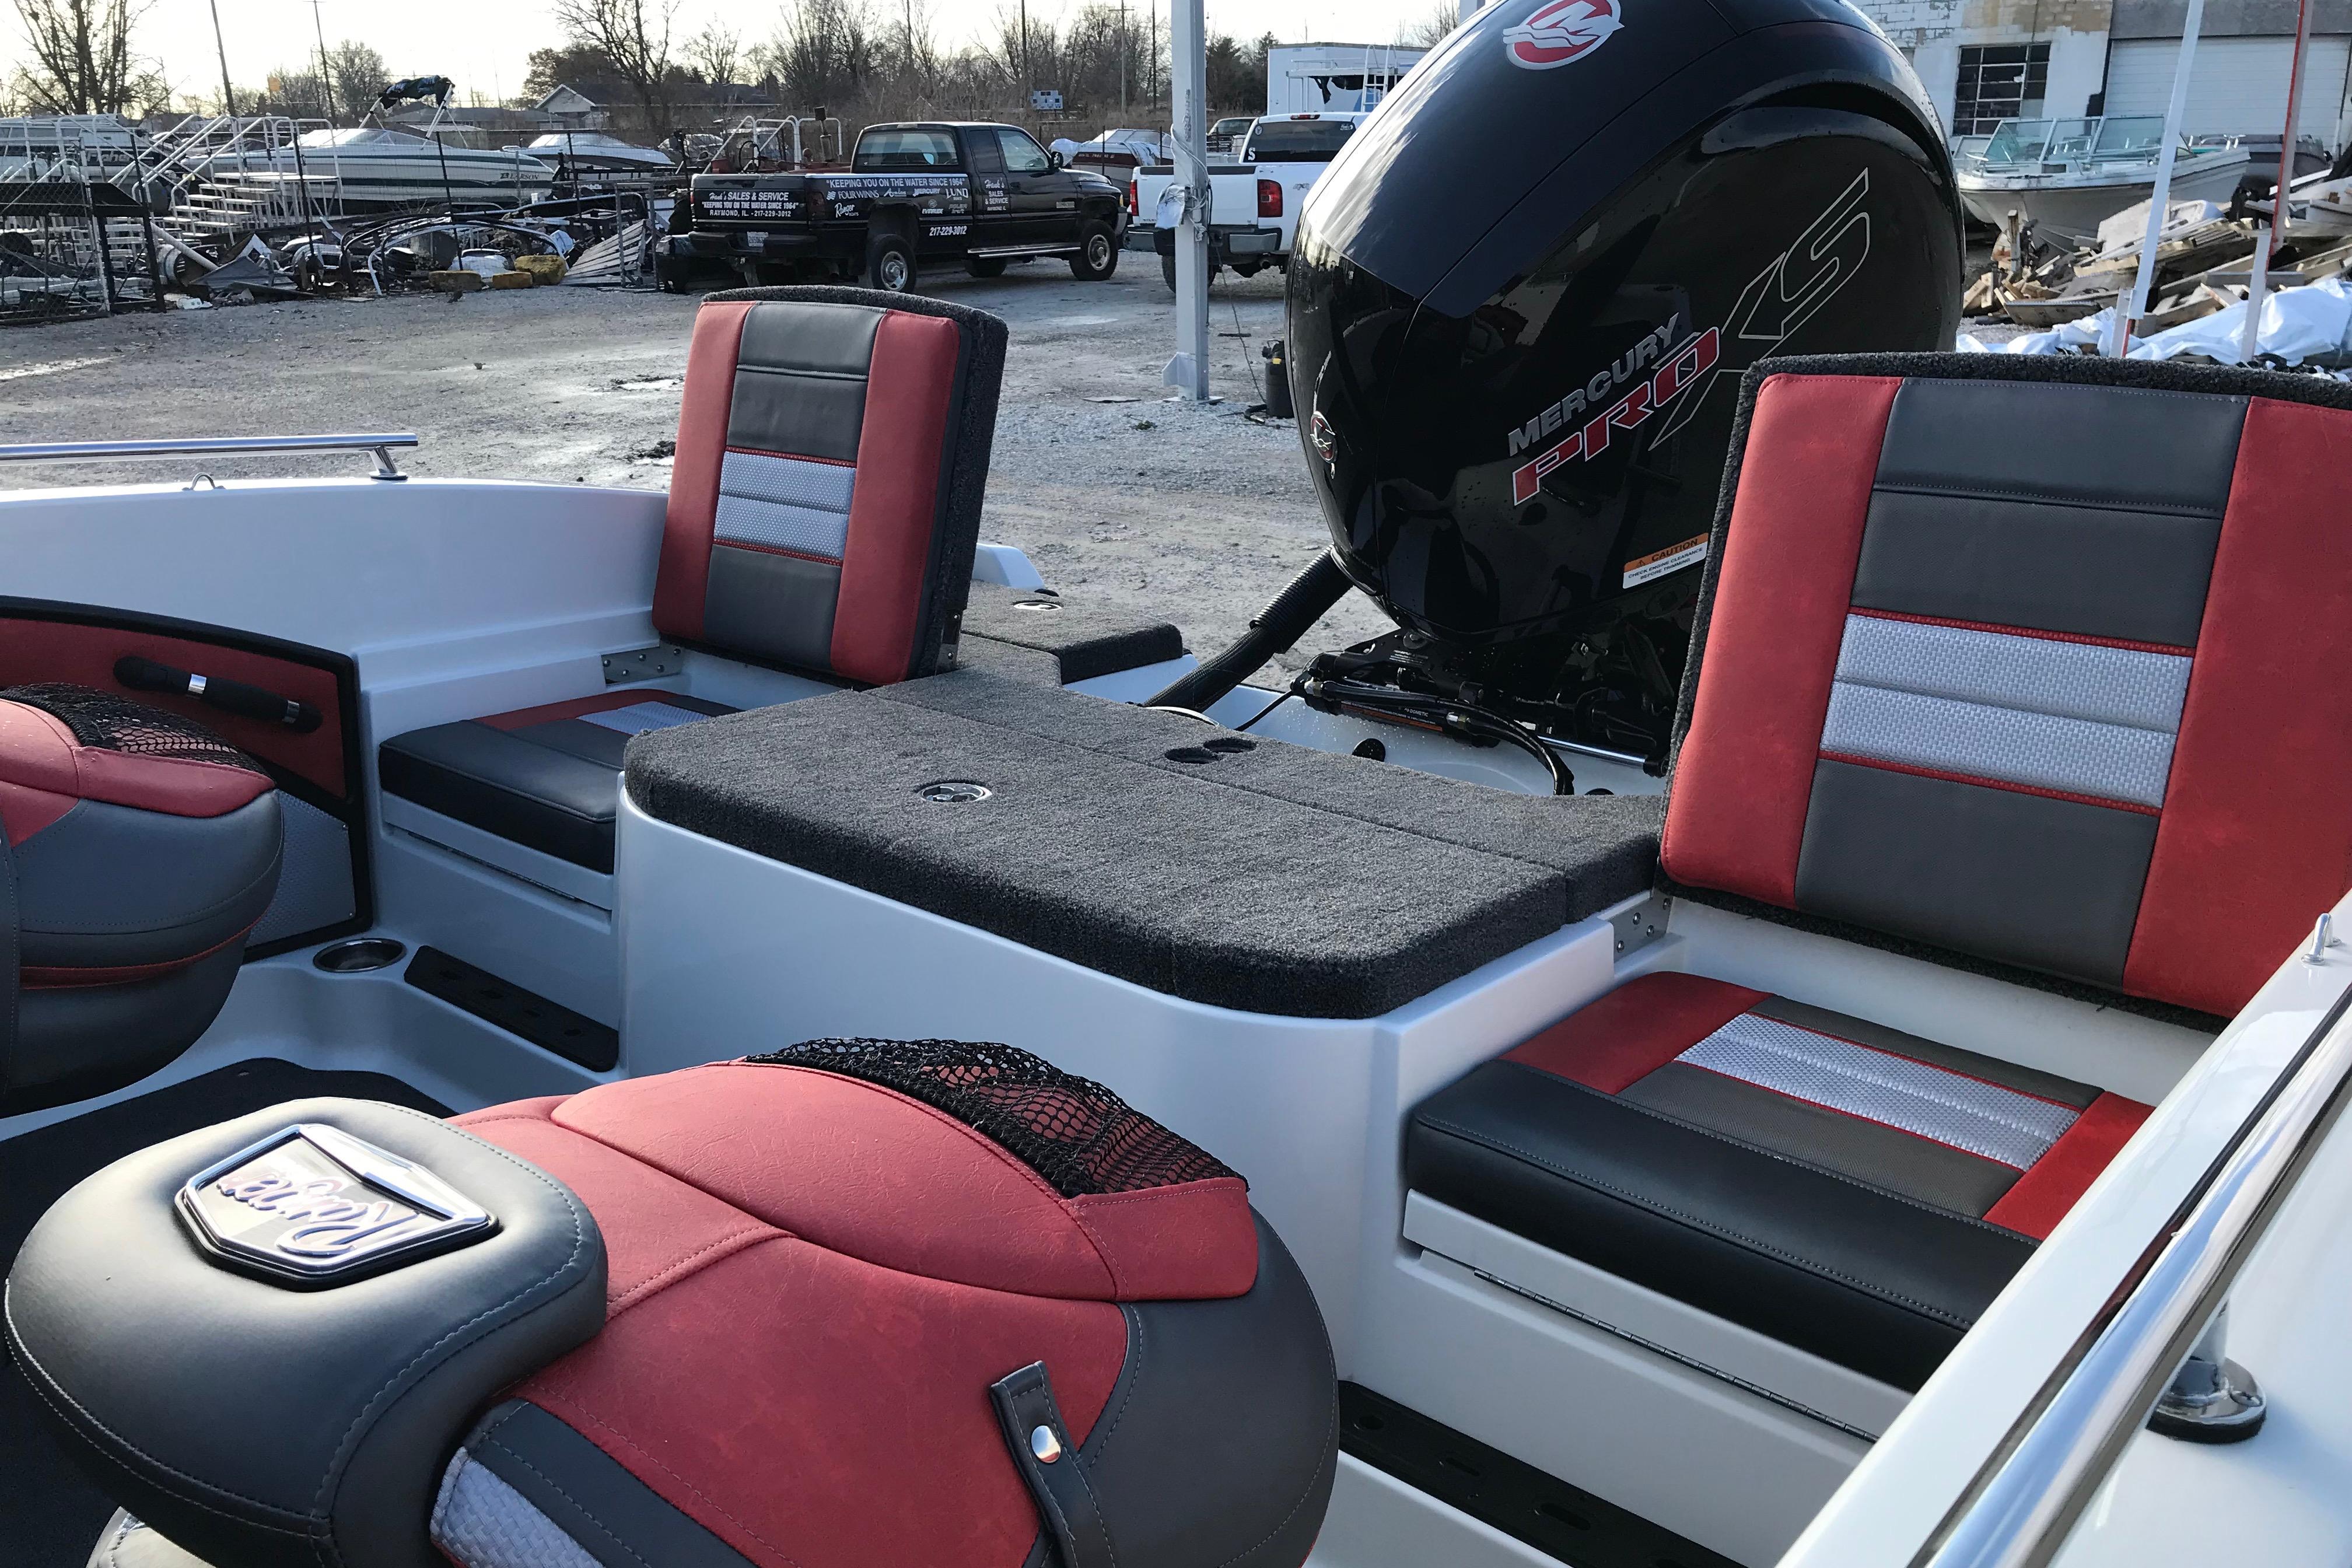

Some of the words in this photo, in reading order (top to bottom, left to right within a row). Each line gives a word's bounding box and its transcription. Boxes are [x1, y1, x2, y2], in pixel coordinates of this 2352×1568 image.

[826, 178, 862, 187] "KEEPING
[863, 178, 877, 187] YOU
[878, 178, 890, 187] ON
[890, 178, 904, 187] THE
[905, 178, 928, 186] WATER
[928, 178, 948, 186] SINCE
[945, 188, 969, 199] LUND
[727, 192, 750, 201] SALES
[751, 192, 757, 201] &
[758, 192, 789, 201] SERVICE
[1508, 312, 1679, 457] MERCURY
[1512, 327, 1720, 506] PRO
[1651, 538, 1699, 562] CAUTION
[1628, 569, 1648, 579] CHECK
[1648, 561, 1670, 571] ENGINE
[1670, 547, 1703, 563] CLEARANCE
[1640, 569, 1662, 580] BEFORE
[1664, 558, 1690, 571] TRIMMING
